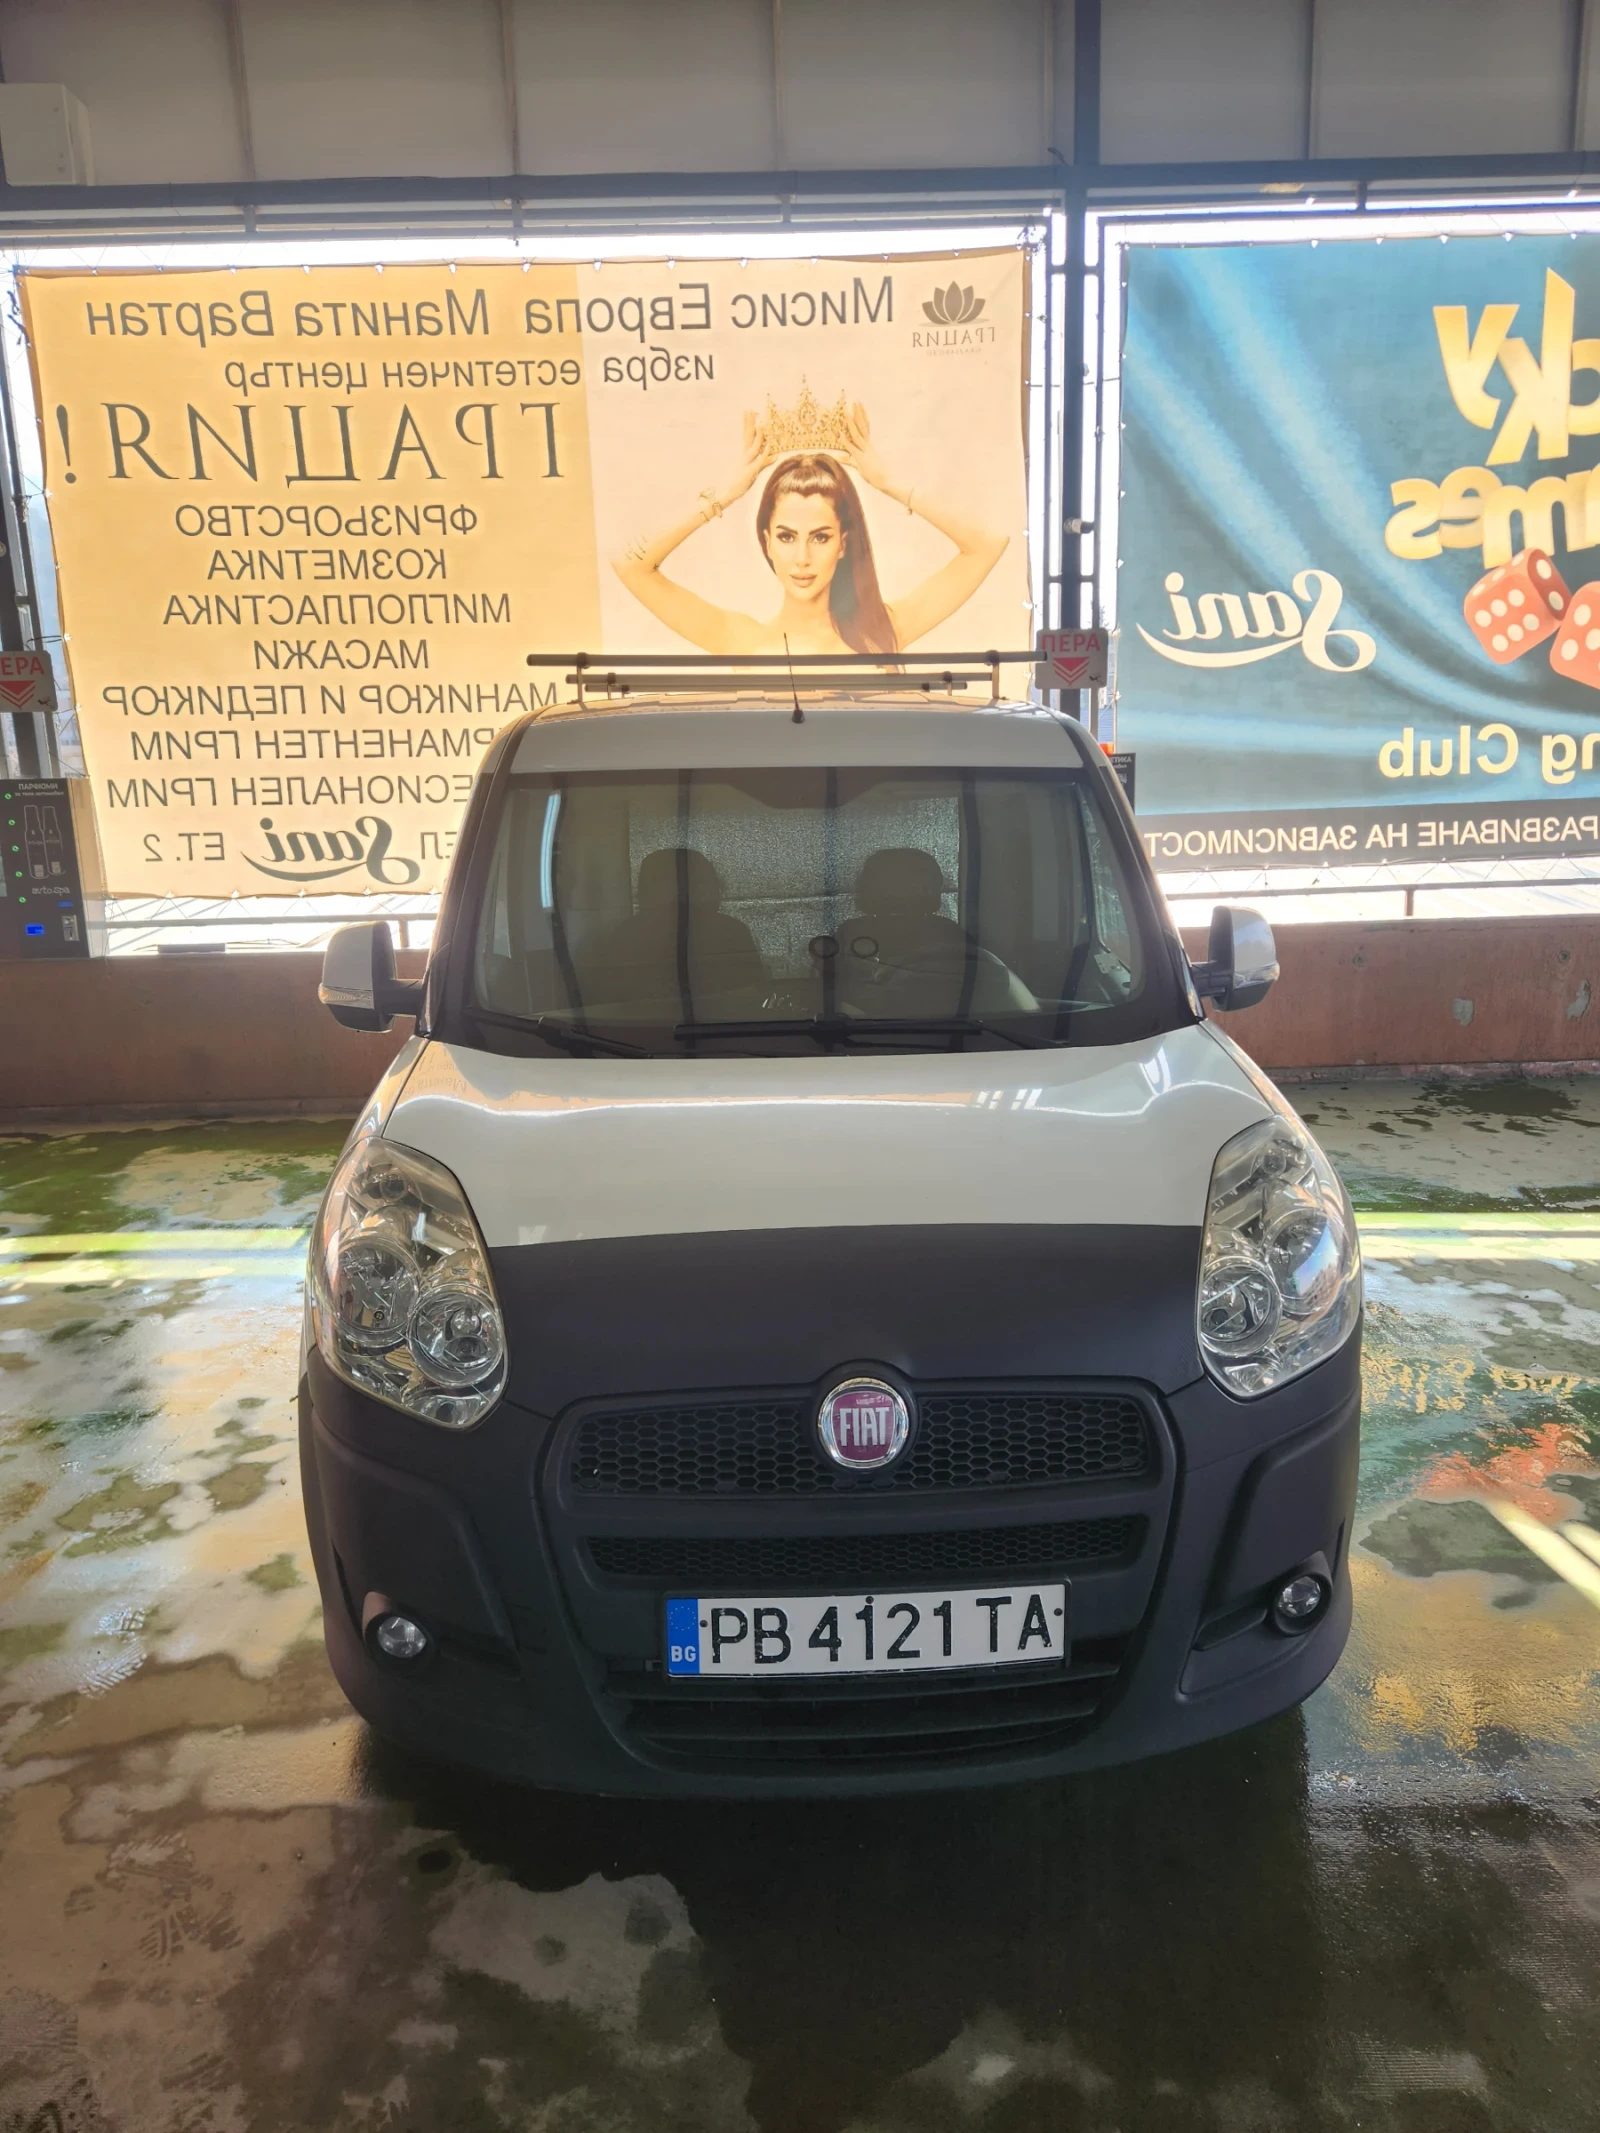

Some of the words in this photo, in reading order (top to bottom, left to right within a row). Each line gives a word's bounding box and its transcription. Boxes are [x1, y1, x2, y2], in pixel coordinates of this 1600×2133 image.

[1041, 633, 1100, 652] ПЕРА
[840, 1406, 889, 1447] FIAT
[710, 1607, 791, 1664] PB
[808, 1600, 952, 1662] 4121
[976, 1594, 1052, 1653] TA
[671, 1645, 696, 1663] BG
